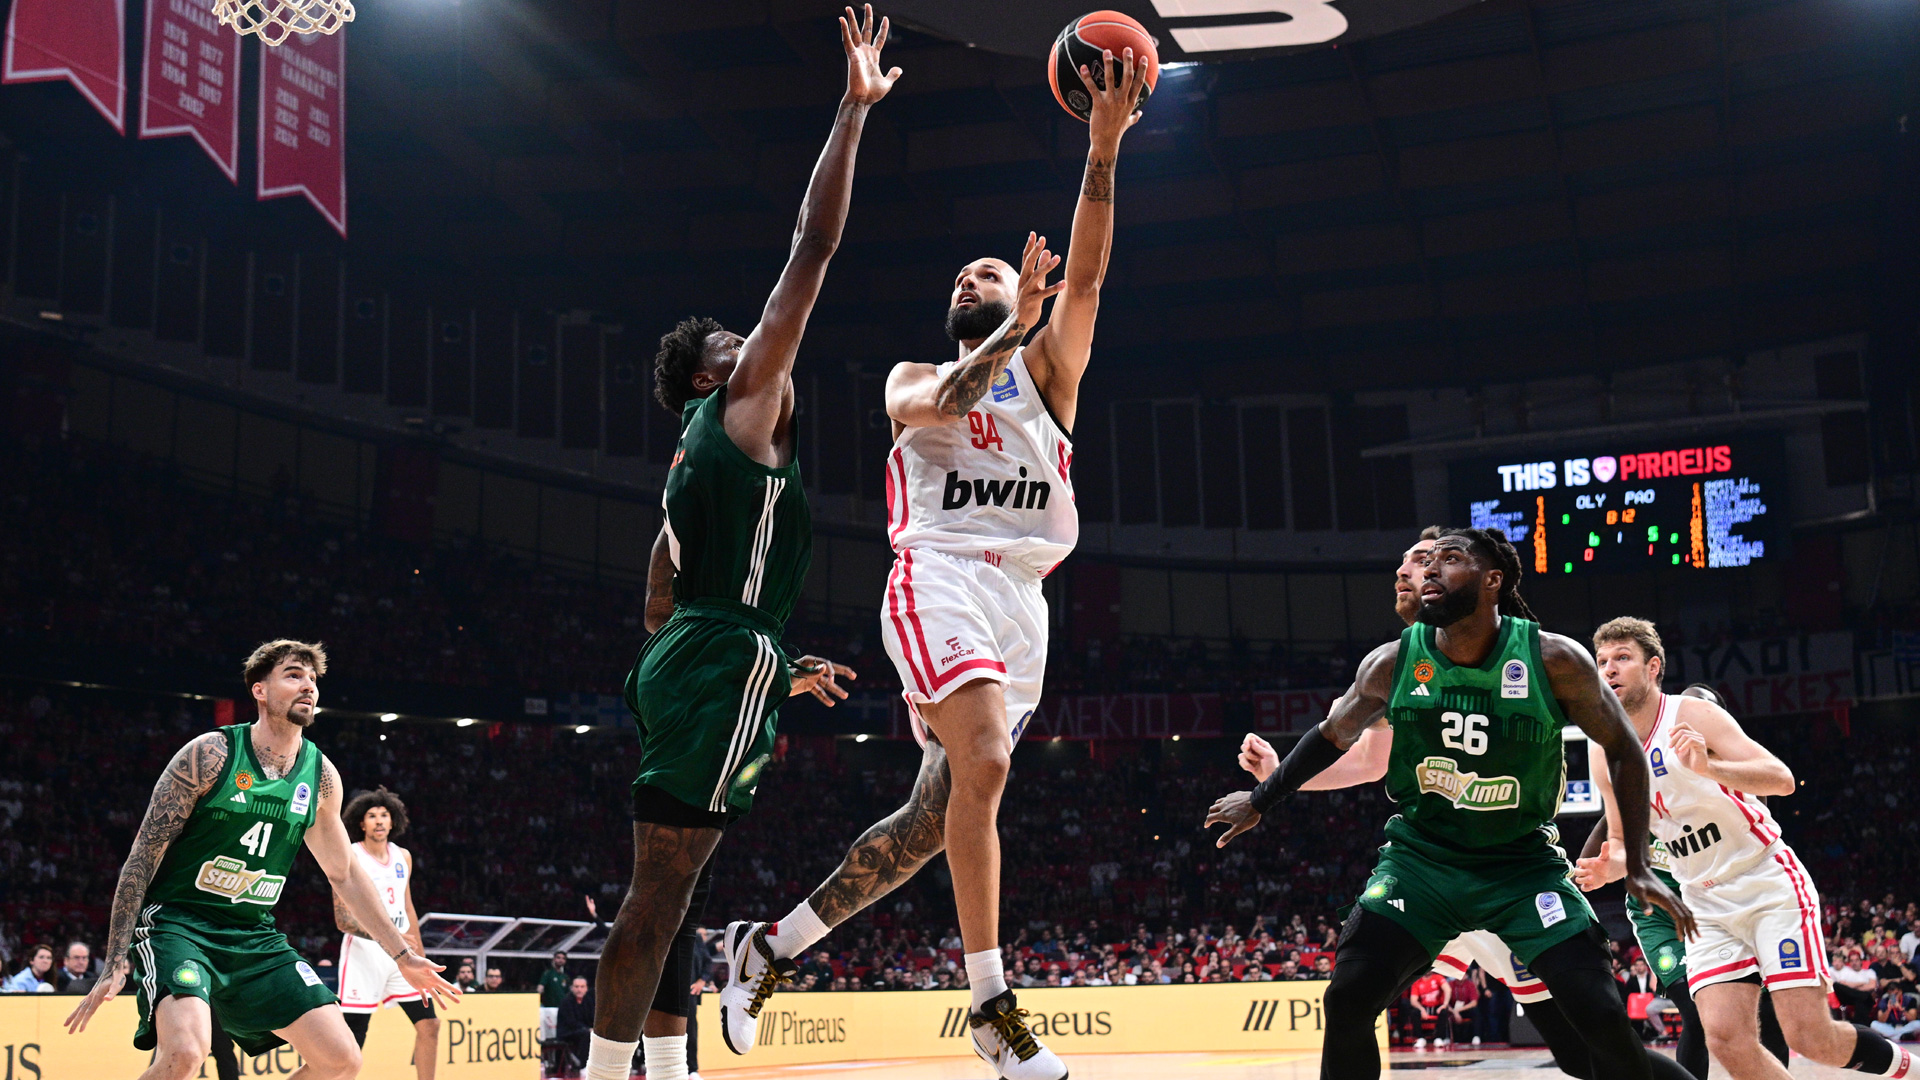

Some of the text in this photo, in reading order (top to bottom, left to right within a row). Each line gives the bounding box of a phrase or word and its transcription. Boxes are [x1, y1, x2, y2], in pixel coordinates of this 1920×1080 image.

[968, 411, 1004, 451] 94
[942, 466, 1051, 510] bwin
[1497, 461, 1556, 492] THIS
[1563, 458, 1591, 487] IS
[1575, 489, 1655, 510] OLY PAO
[984, 550, 1002, 568] OLY
[941, 648, 975, 666] FlexCar
[1440, 711, 1489, 756] 26
[239, 821, 274, 858] 41
[1665, 822, 1722, 859] win
[387, 887, 395, 905] 3
[781, 1010, 846, 1045] Piraeus
[1026, 1011, 1113, 1036] aeus
[1288, 998, 1325, 1031] Pi
